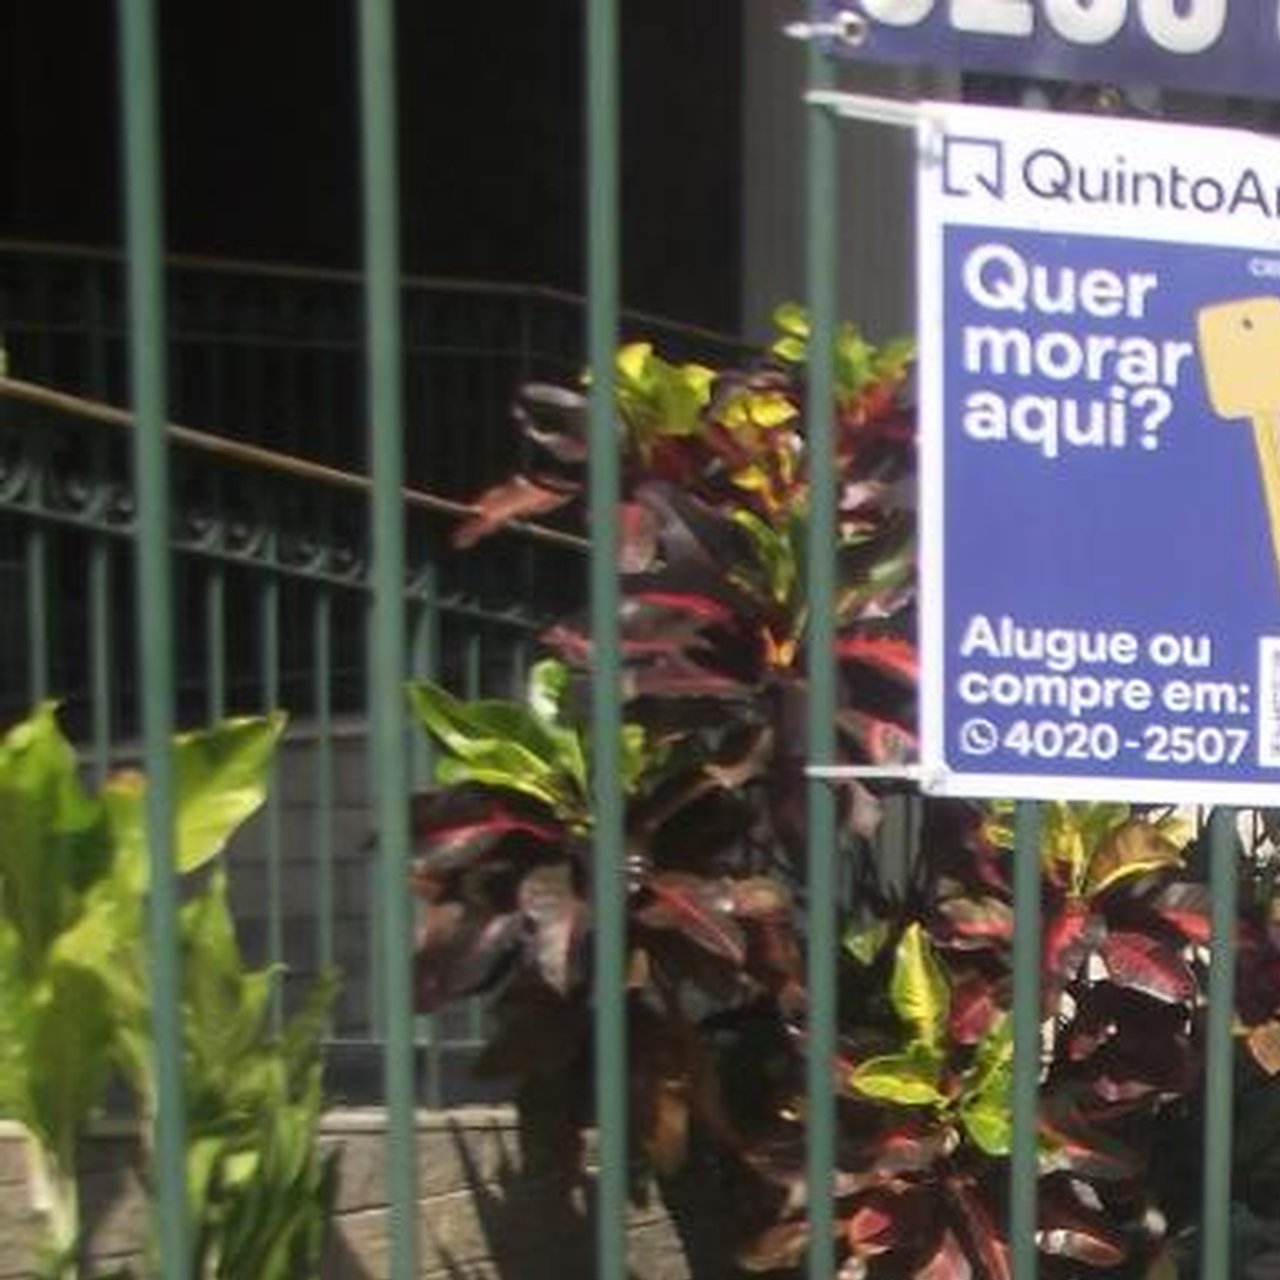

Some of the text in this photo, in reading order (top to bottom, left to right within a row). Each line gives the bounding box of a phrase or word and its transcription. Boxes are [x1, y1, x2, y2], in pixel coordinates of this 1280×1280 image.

[960, 243, 1158, 321] Quer
[962, 323, 1194, 388] morar
[962, 388, 1174, 458] aqui?
[961, 615, 1212, 670] Alugue ou
[958, 669, 1252, 716] compre em:
[1004, 721, 1250, 764] 4020-2507
